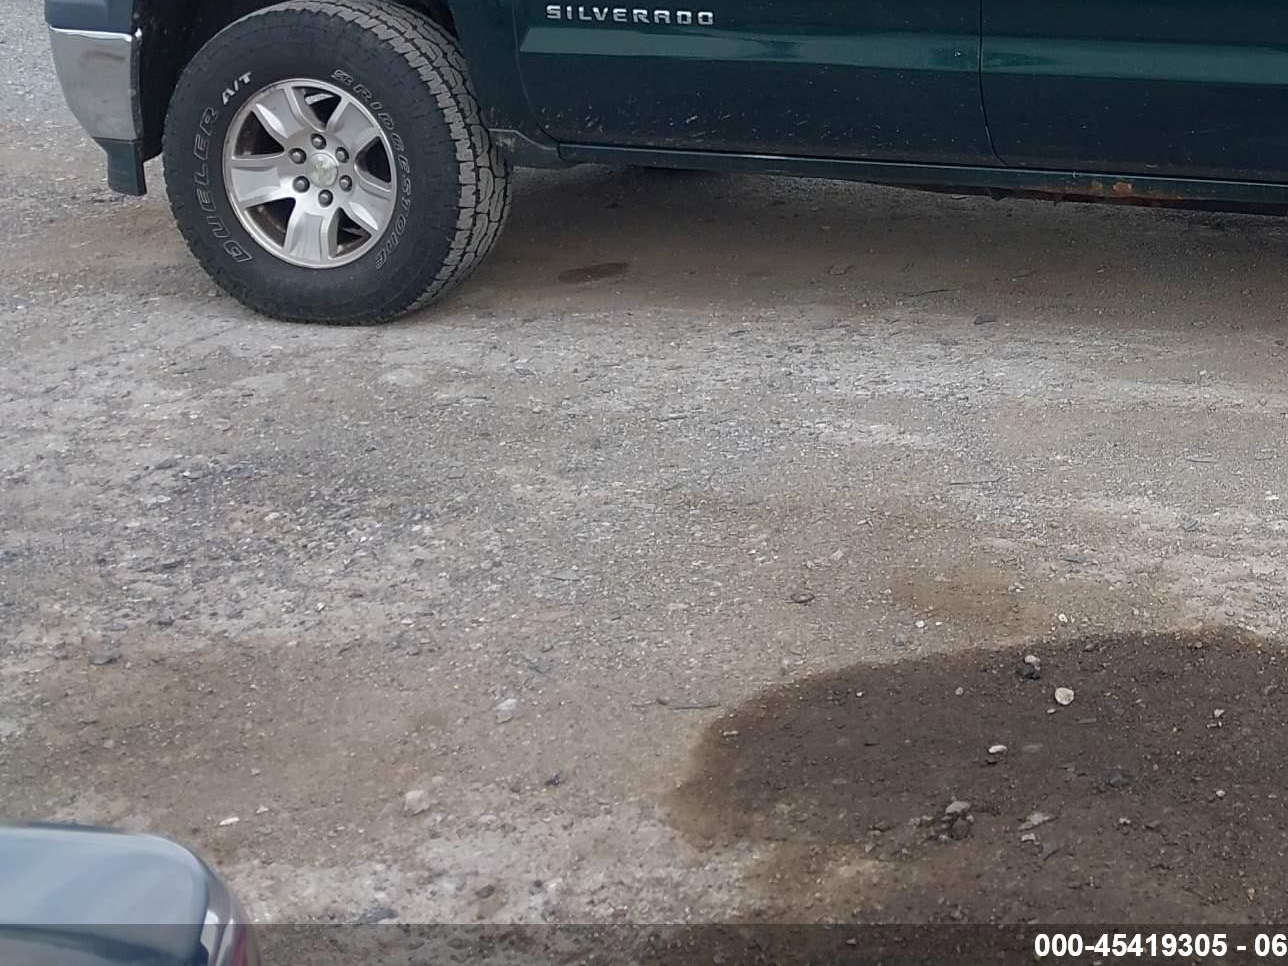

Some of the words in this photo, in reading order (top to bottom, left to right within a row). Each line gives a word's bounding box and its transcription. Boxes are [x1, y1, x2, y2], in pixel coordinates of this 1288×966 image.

[546, 4, 714, 26] SILVERADO
[221, 71, 252, 106] A/T
[194, 106, 253, 264] DUELER
[331, 69, 412, 270] BRIDGESTONE
